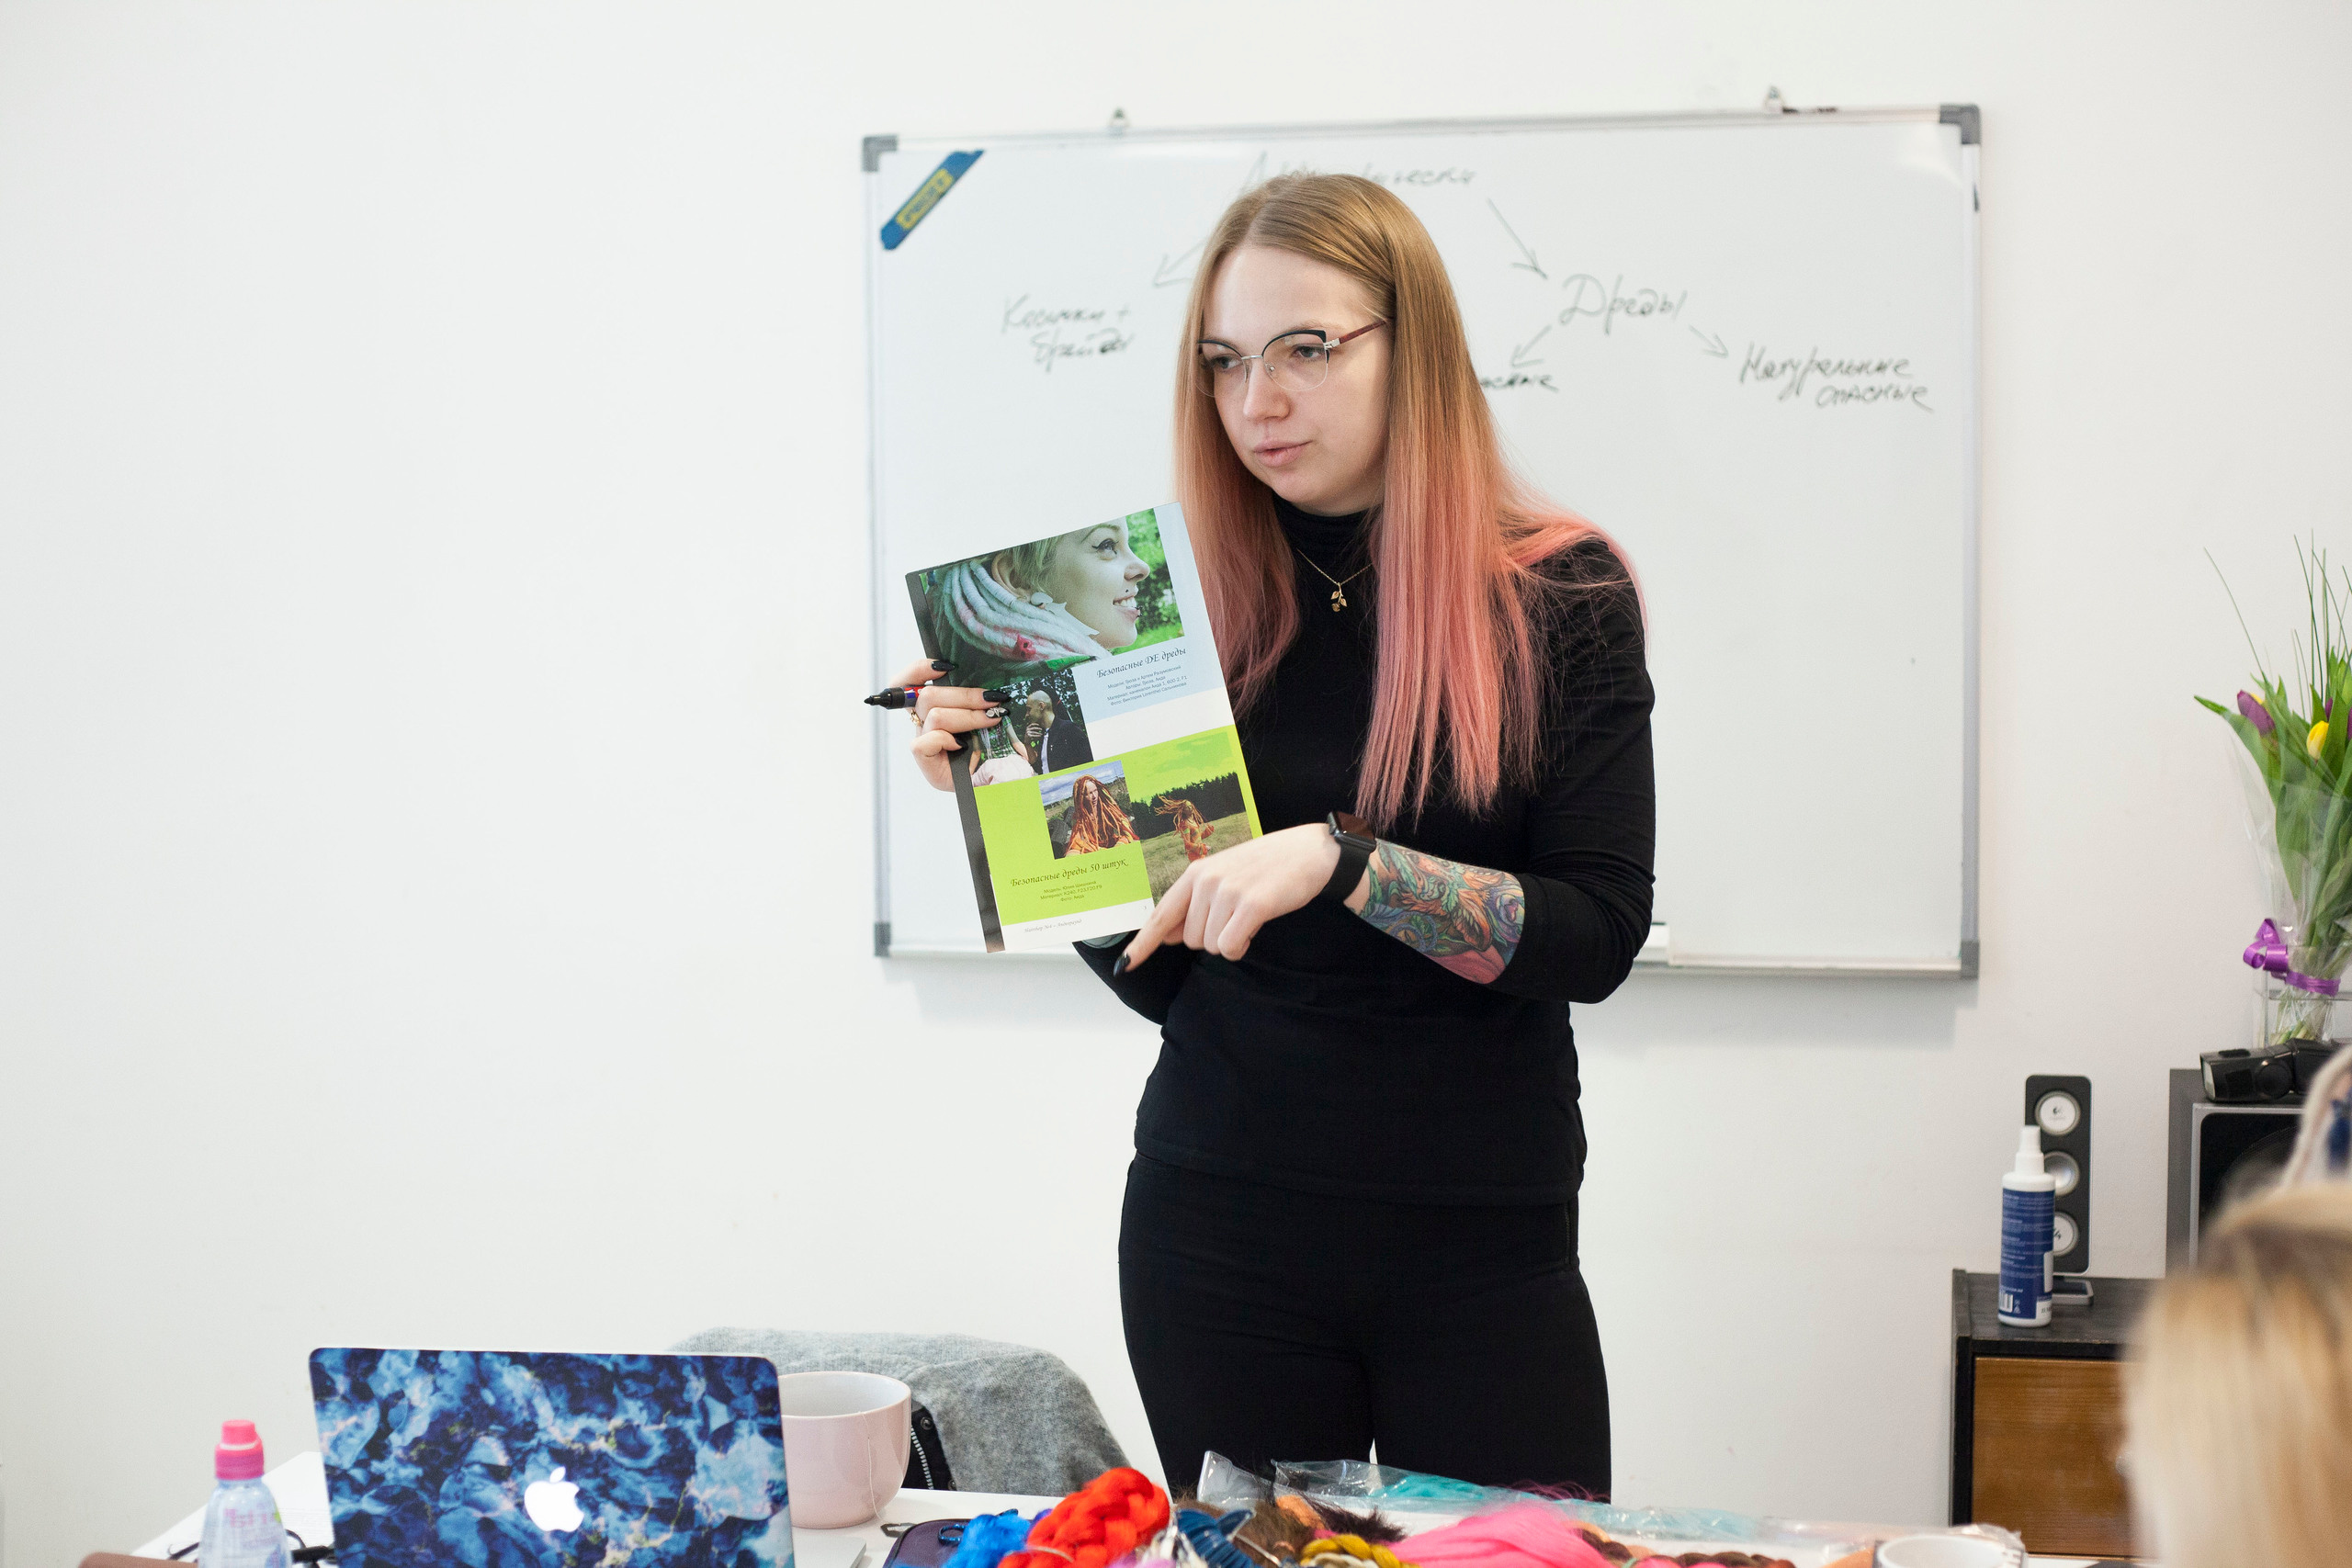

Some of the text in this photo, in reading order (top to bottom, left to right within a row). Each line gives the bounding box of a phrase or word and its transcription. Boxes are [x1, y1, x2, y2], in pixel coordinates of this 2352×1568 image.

[1557, 273, 1688, 336] Дреды
[1097, 648, 1186, 678] Безопасные DE дреды
[1011, 859, 1128, 886] Безопасные дреды 50 штук
